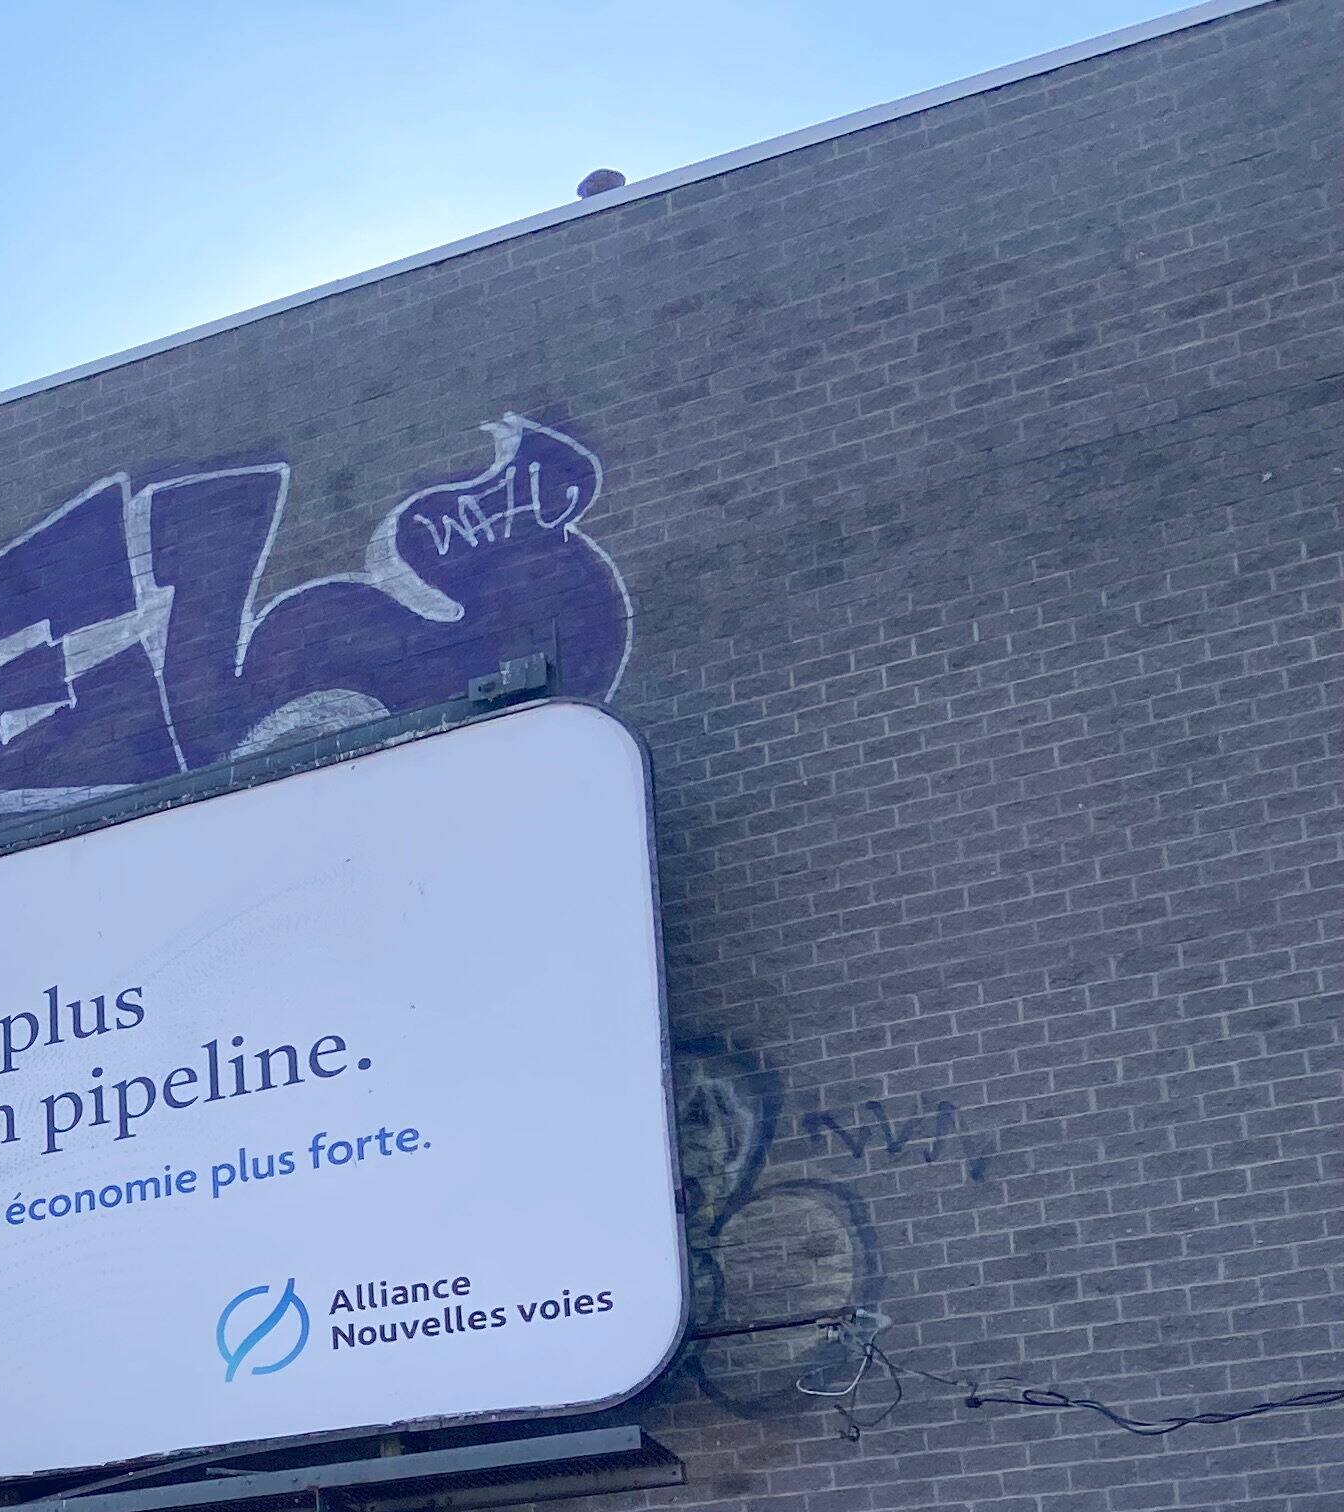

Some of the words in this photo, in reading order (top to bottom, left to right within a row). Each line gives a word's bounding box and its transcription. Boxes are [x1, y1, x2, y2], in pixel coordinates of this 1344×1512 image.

[41, 1032, 374, 1154] pipeline.
[4, 1163, 198, 1227] économie
[211, 1145, 297, 1199] plus
[307, 1123, 433, 1171] forte.
[328, 1272, 473, 1317] Alliance
[329, 1299, 508, 1351] Nouvelles
[516, 1285, 615, 1324] voies
